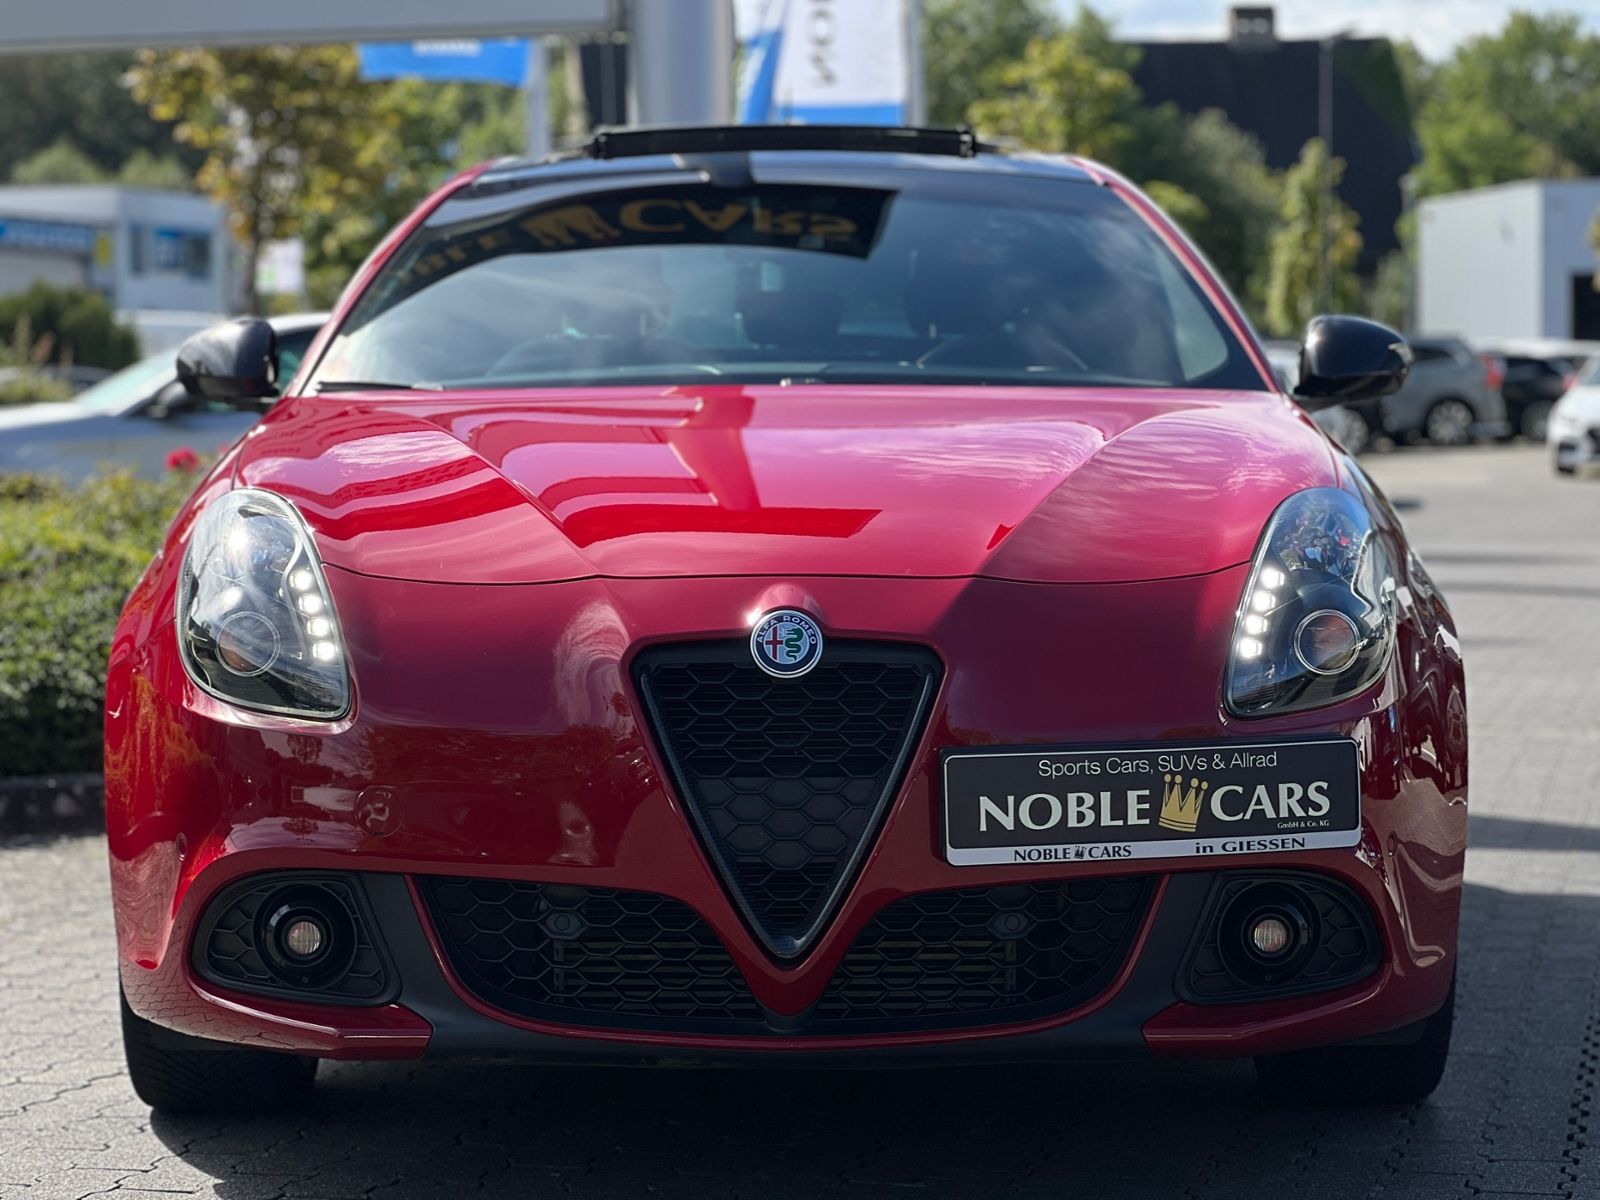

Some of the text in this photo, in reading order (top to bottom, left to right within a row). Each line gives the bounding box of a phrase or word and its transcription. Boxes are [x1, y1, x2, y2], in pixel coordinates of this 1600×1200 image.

[757, 615, 817, 645] ALFA ROMEO
[1038, 750, 1278, 780] Sports Cars, SUVs & Allrad
[979, 781, 1331, 832] NOBLE CARS
[1277, 821, 1299, 829] GmbH
[1320, 819, 1330, 827] KG
[1014, 837, 1306, 862] NOBLE CARS in GIESSEN
